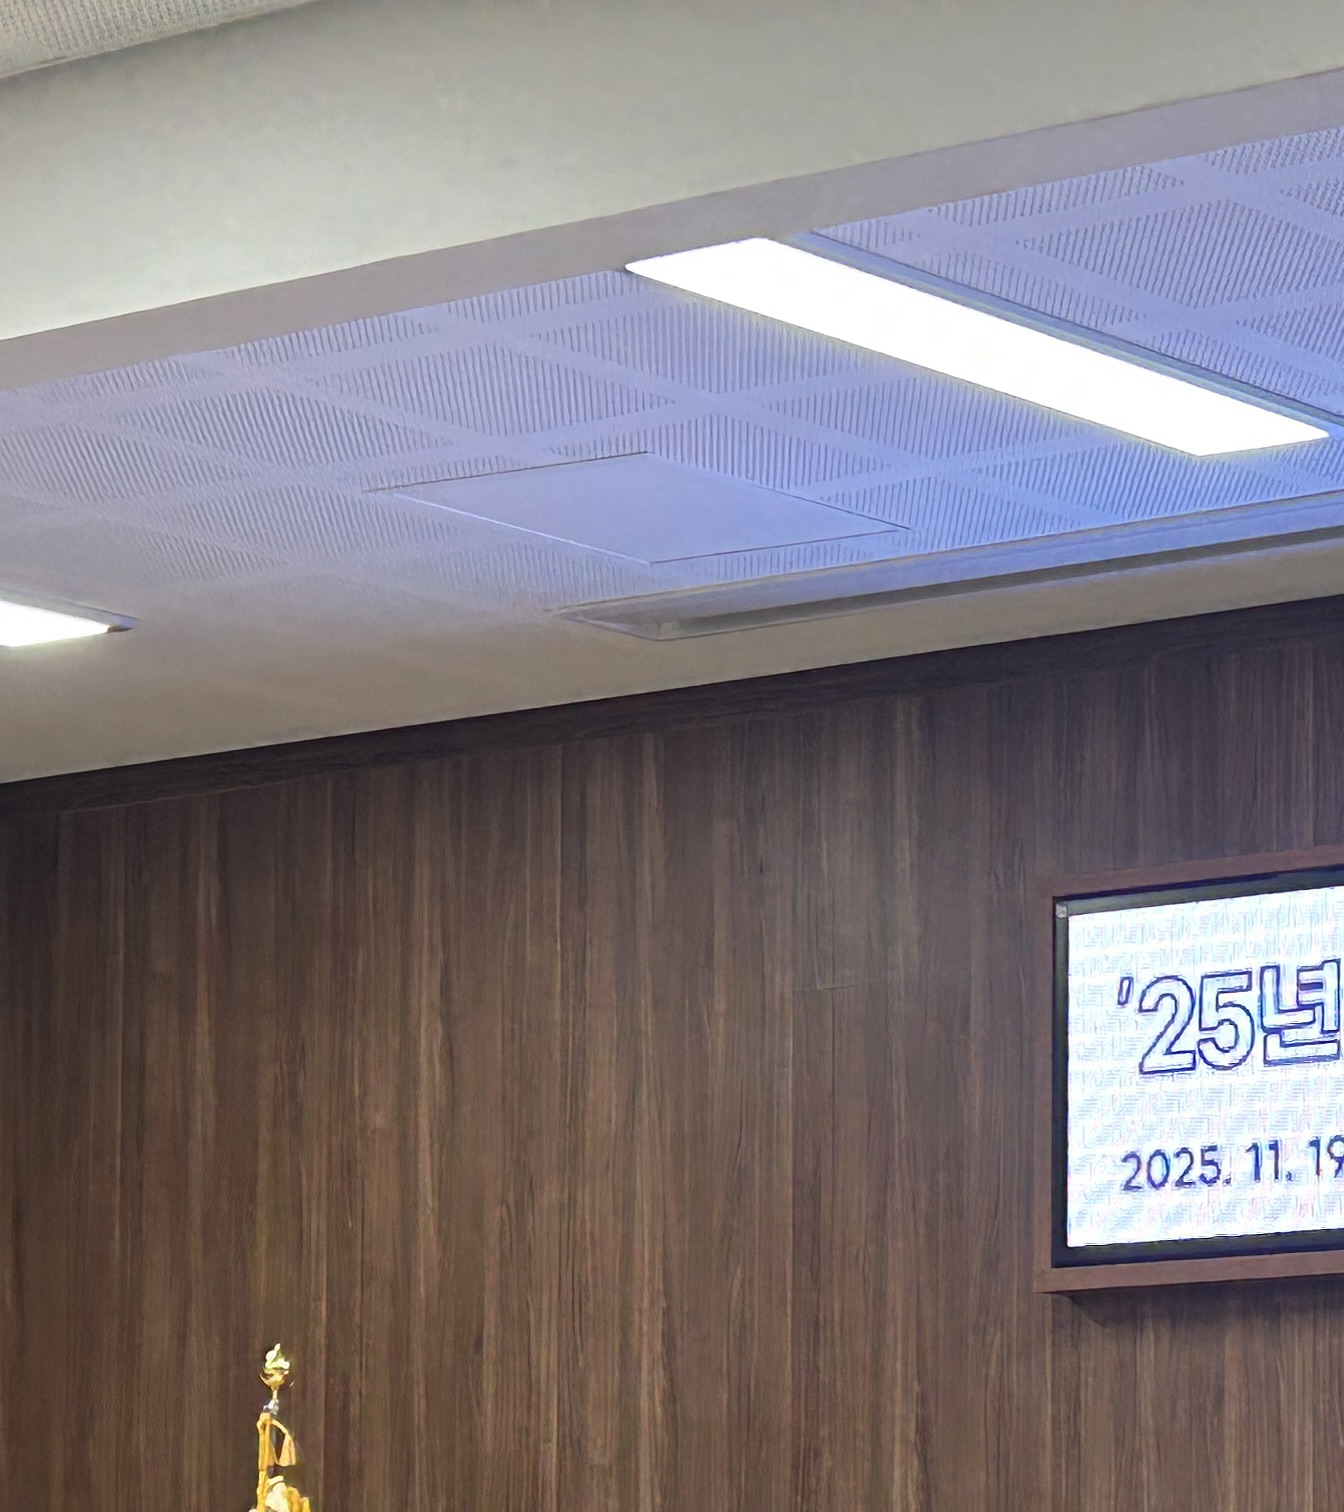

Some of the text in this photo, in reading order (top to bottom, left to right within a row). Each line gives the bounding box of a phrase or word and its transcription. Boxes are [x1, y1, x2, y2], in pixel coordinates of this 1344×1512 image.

[1117, 959, 1342, 1075] '25년
[1121, 1144, 1232, 1192] 2025.
[1244, 1139, 1294, 1183] 11.
